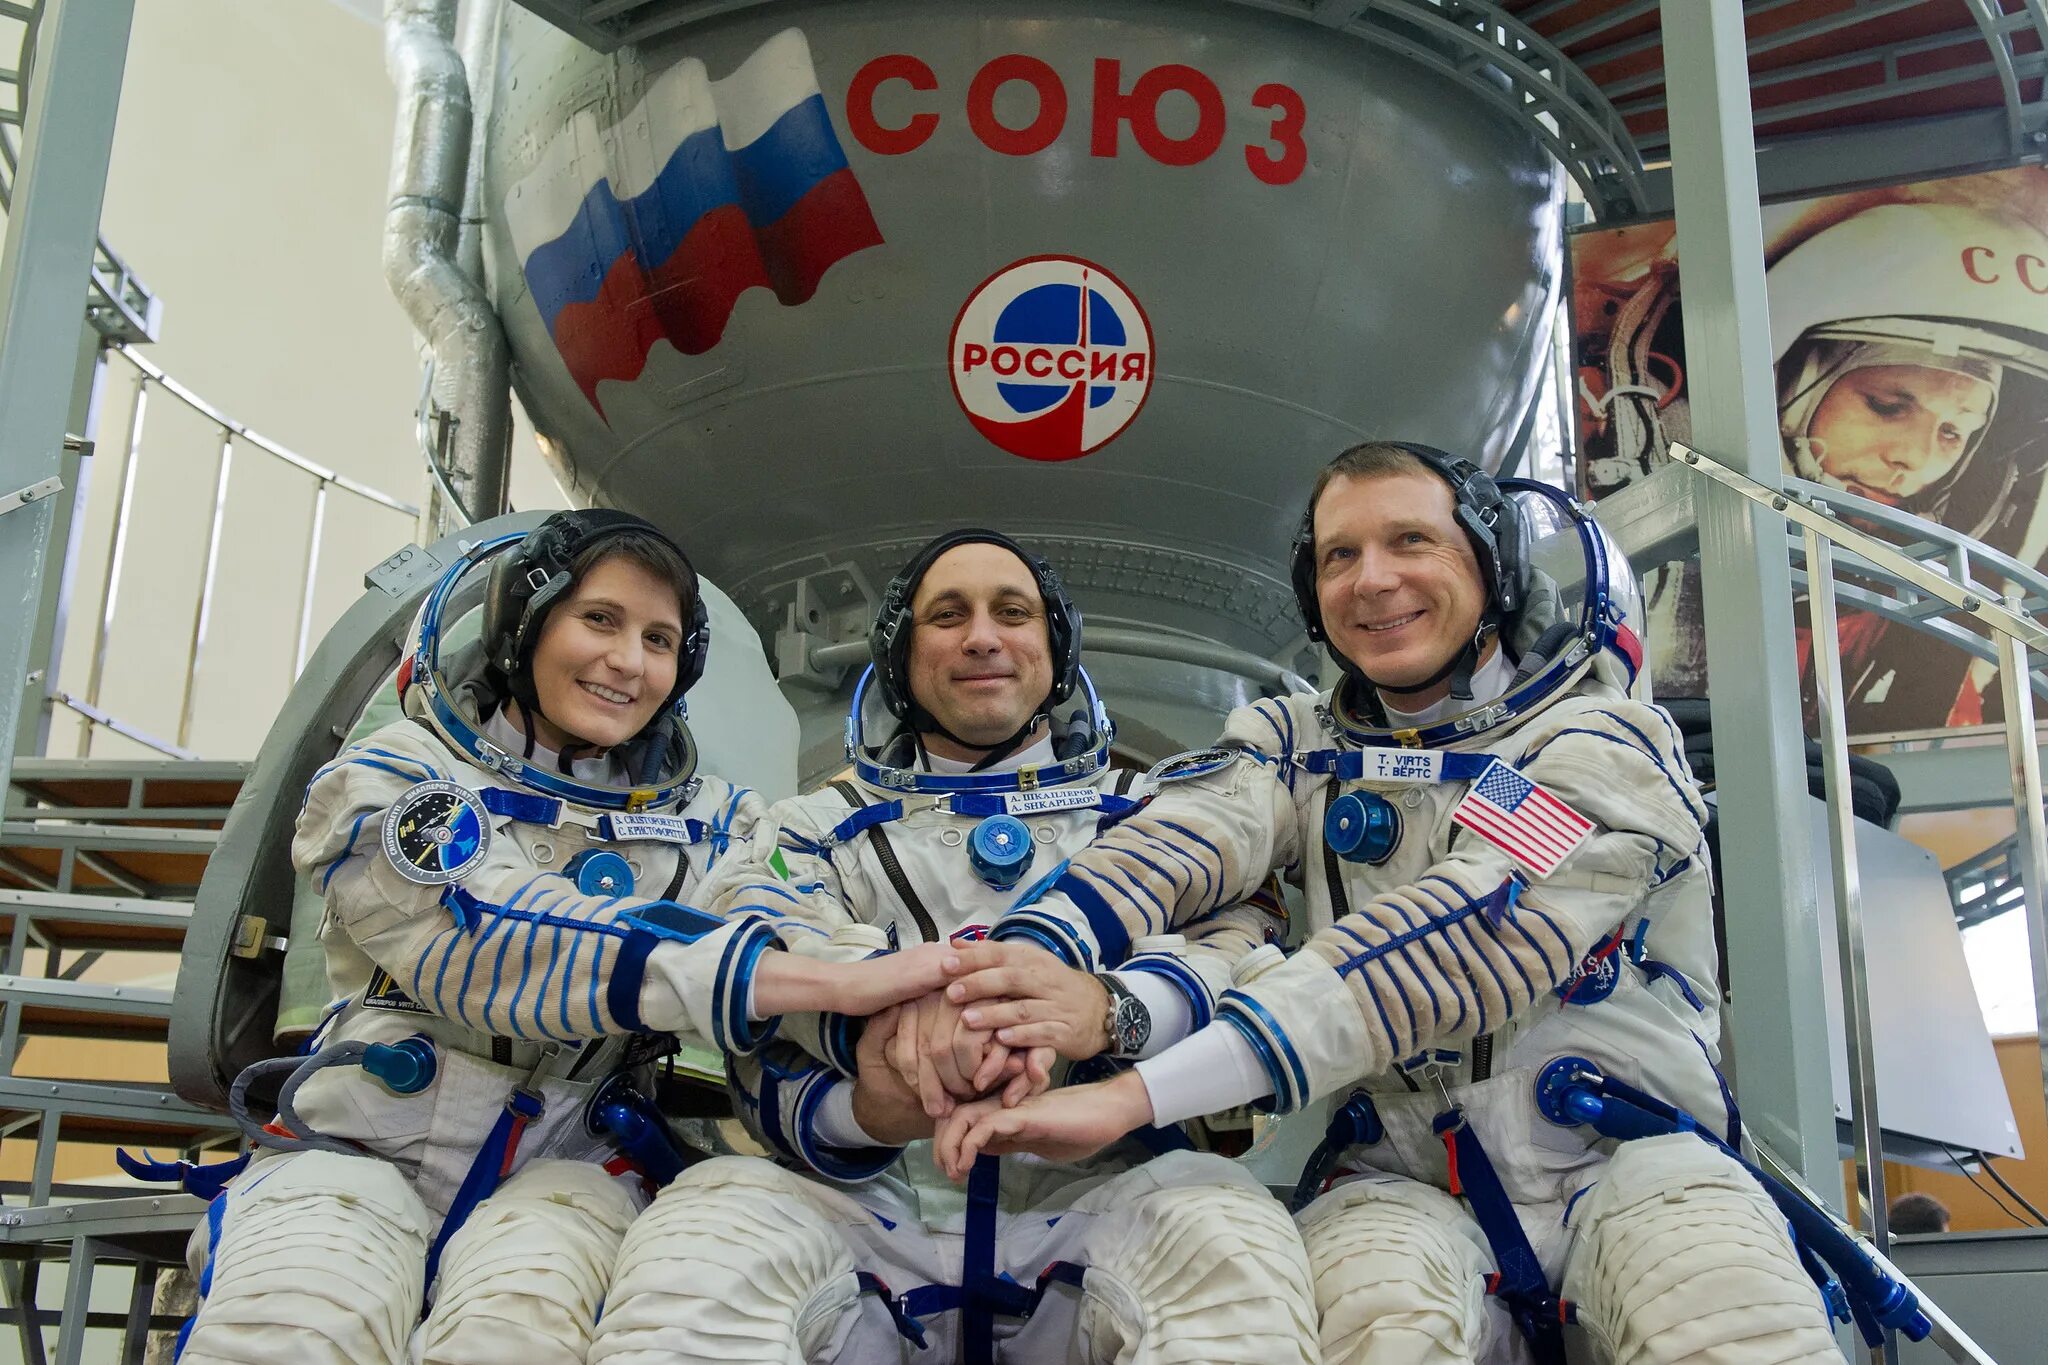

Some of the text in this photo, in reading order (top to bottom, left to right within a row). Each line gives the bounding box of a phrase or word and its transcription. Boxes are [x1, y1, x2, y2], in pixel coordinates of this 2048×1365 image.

[846, 54, 1307, 185] СОЮЗ
[963, 343, 1146, 381] РОССИЯ
[1378, 753, 1431, 767] T. VIRTS
[1377, 765, 1431, 778] Т. ВЁРТС
[455, 787, 475, 802] VIRTS
[1011, 789, 1094, 803] А. ШКАПЛЕРОВ
[1011, 796, 1097, 812] A. SHKAPLEROV
[624, 815, 684, 829] CRISTOFORETTI
[386, 804, 402, 856] CRISTOFORETTI
